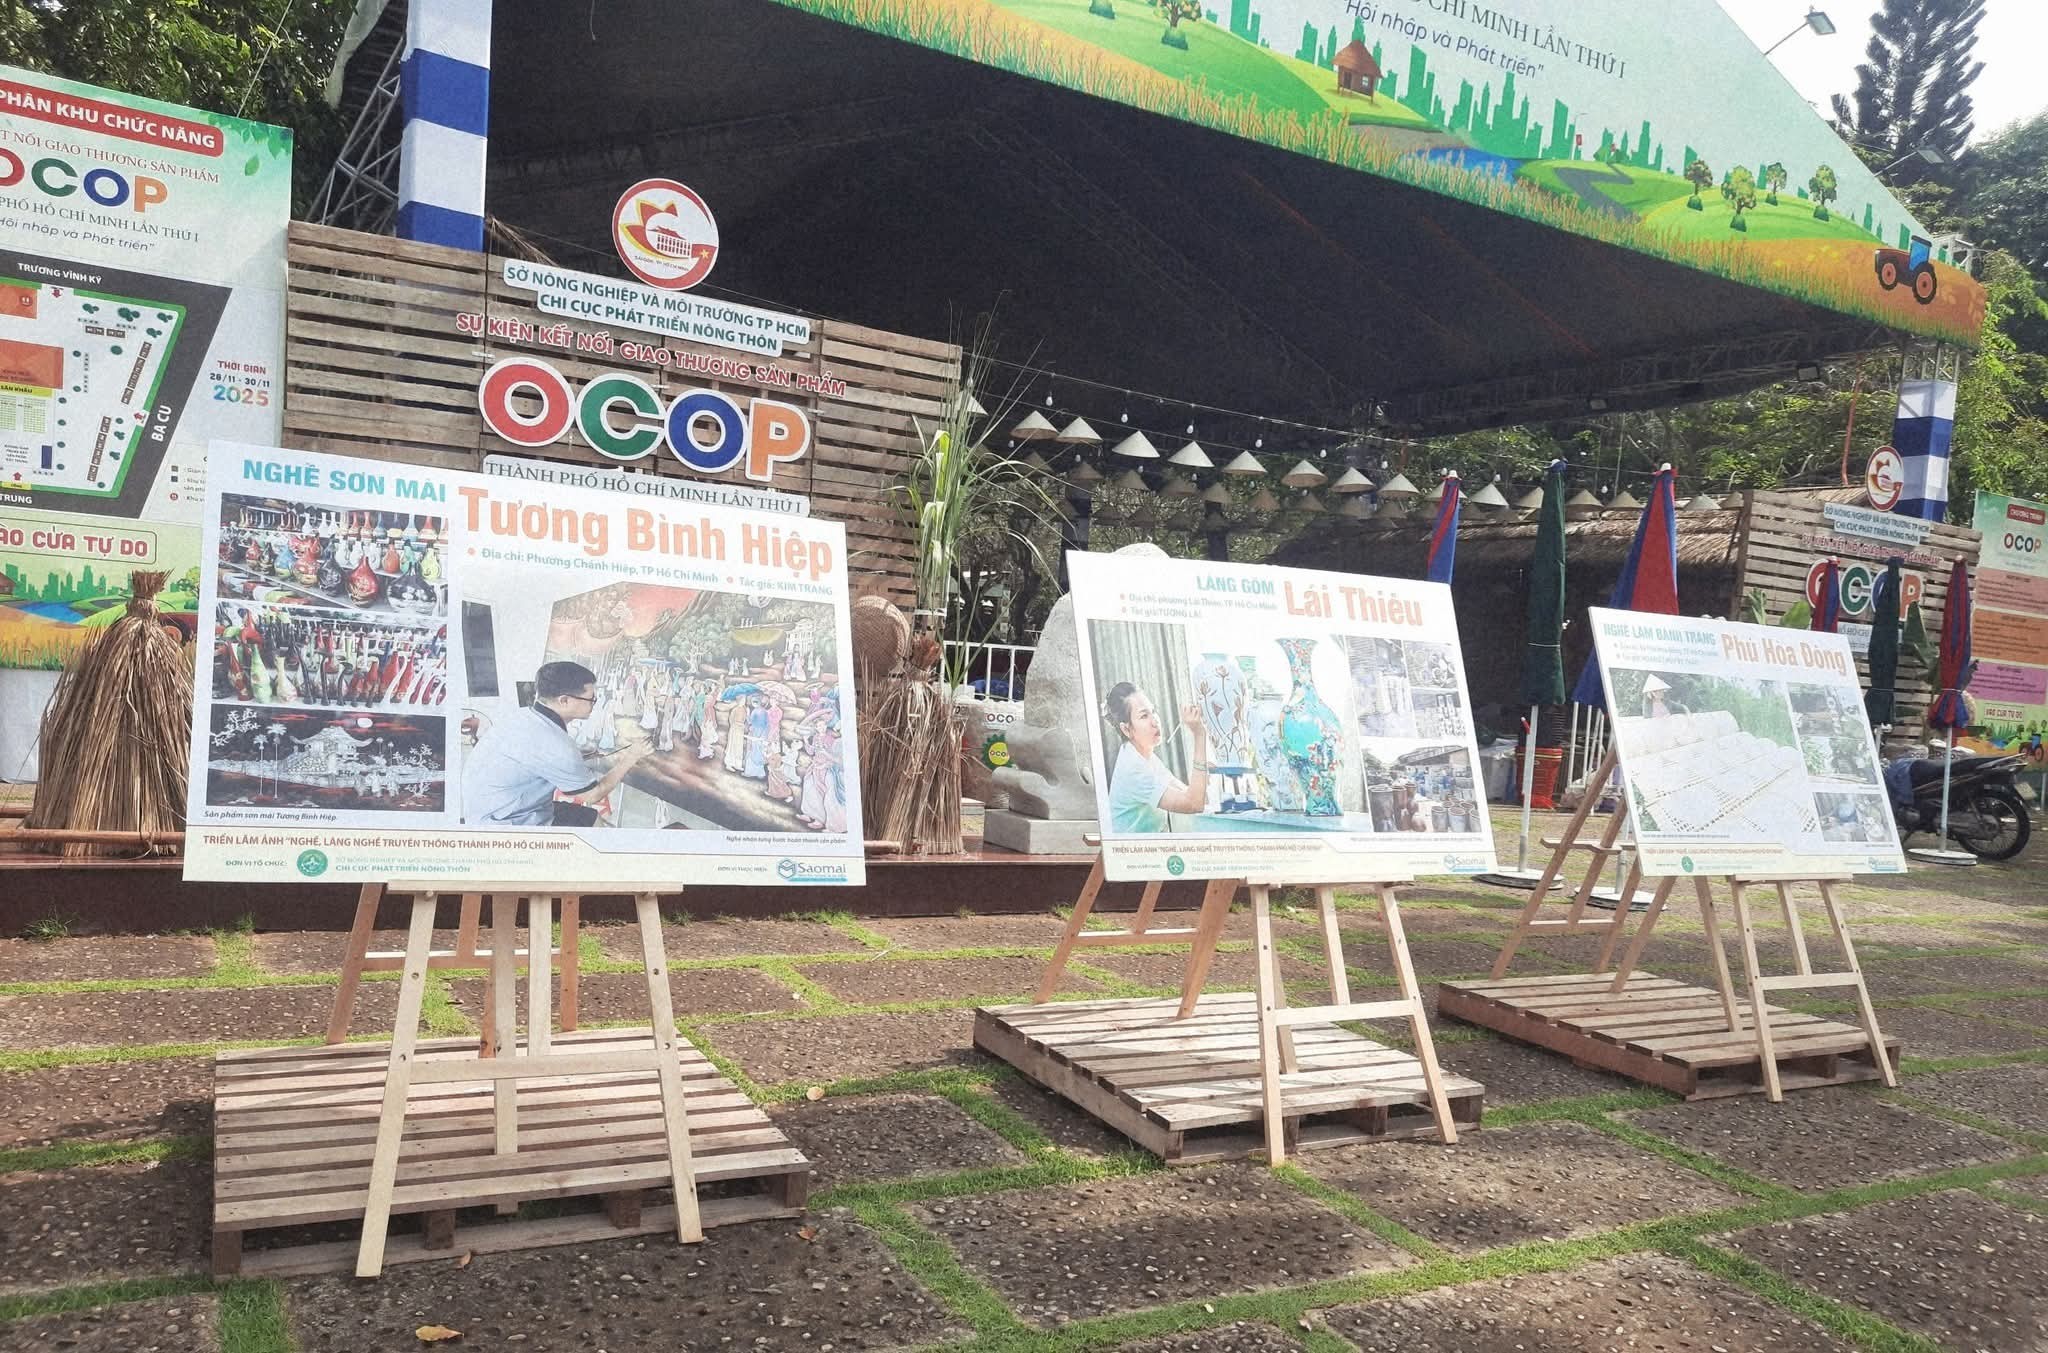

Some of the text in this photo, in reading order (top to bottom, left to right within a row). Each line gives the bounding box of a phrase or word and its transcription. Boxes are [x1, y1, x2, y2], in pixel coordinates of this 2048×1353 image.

[1380, 12, 1428, 42] nhập
[1432, 28, 1452, 49] và
[1456, 36, 1495, 65] Phát
[1471, 4, 1529, 42] MINH
[1533, 25, 1572, 57] LẦN
[1575, 44, 1617, 74] THỨ
[56, 102, 98, 123] KHU
[103, 113, 157, 136] CHỨC
[161, 125, 215, 148] NĂNG
[14, 131, 40, 147] NỐI
[45, 139, 81, 155] GIAO
[85, 147, 147, 169] THƯƠNG
[59, 208, 85, 222] CHÍ
[89, 213, 128, 230] MINH
[83, 231, 114, 245] Phát
[17, 262, 61, 277] TRƯƠNG
[507, 265, 807, 338] SỞ NÔNG NGHIỆP VÀ MÔI TRƯỜNG TP HCM
[540, 294, 777, 350] CHI CỤC PHÁT TRIỂN NÔNG THÔN
[243, 363, 267, 375] GIAN
[456, 313, 847, 396] SỰ KIỆN KẾT NỐI GIAO THƯƠNG SẢN PHẨM
[213, 384, 269, 407] 2025
[479, 357, 812, 482] OCOP
[329, 469, 385, 496] SƠN
[486, 462, 554, 482] THÀNH
[560, 471, 598, 488] PHỐ
[634, 480, 666, 496] CHÍ
[670, 485, 717, 503] MINH
[757, 497, 793, 513] THỨ
[32, 525, 148, 557] CỬA TỰ DO
[458, 486, 833, 580] Tương Bình Hiệp
[2004, 533, 2042, 553] OCOP
[641, 565, 654, 576] TP
[693, 572, 719, 584] Minh
[777, 581, 797, 593] KIM
[800, 584, 833, 596] TRANG
[1284, 580, 1333, 618] Lái
[1721, 633, 1760, 662] Phú
